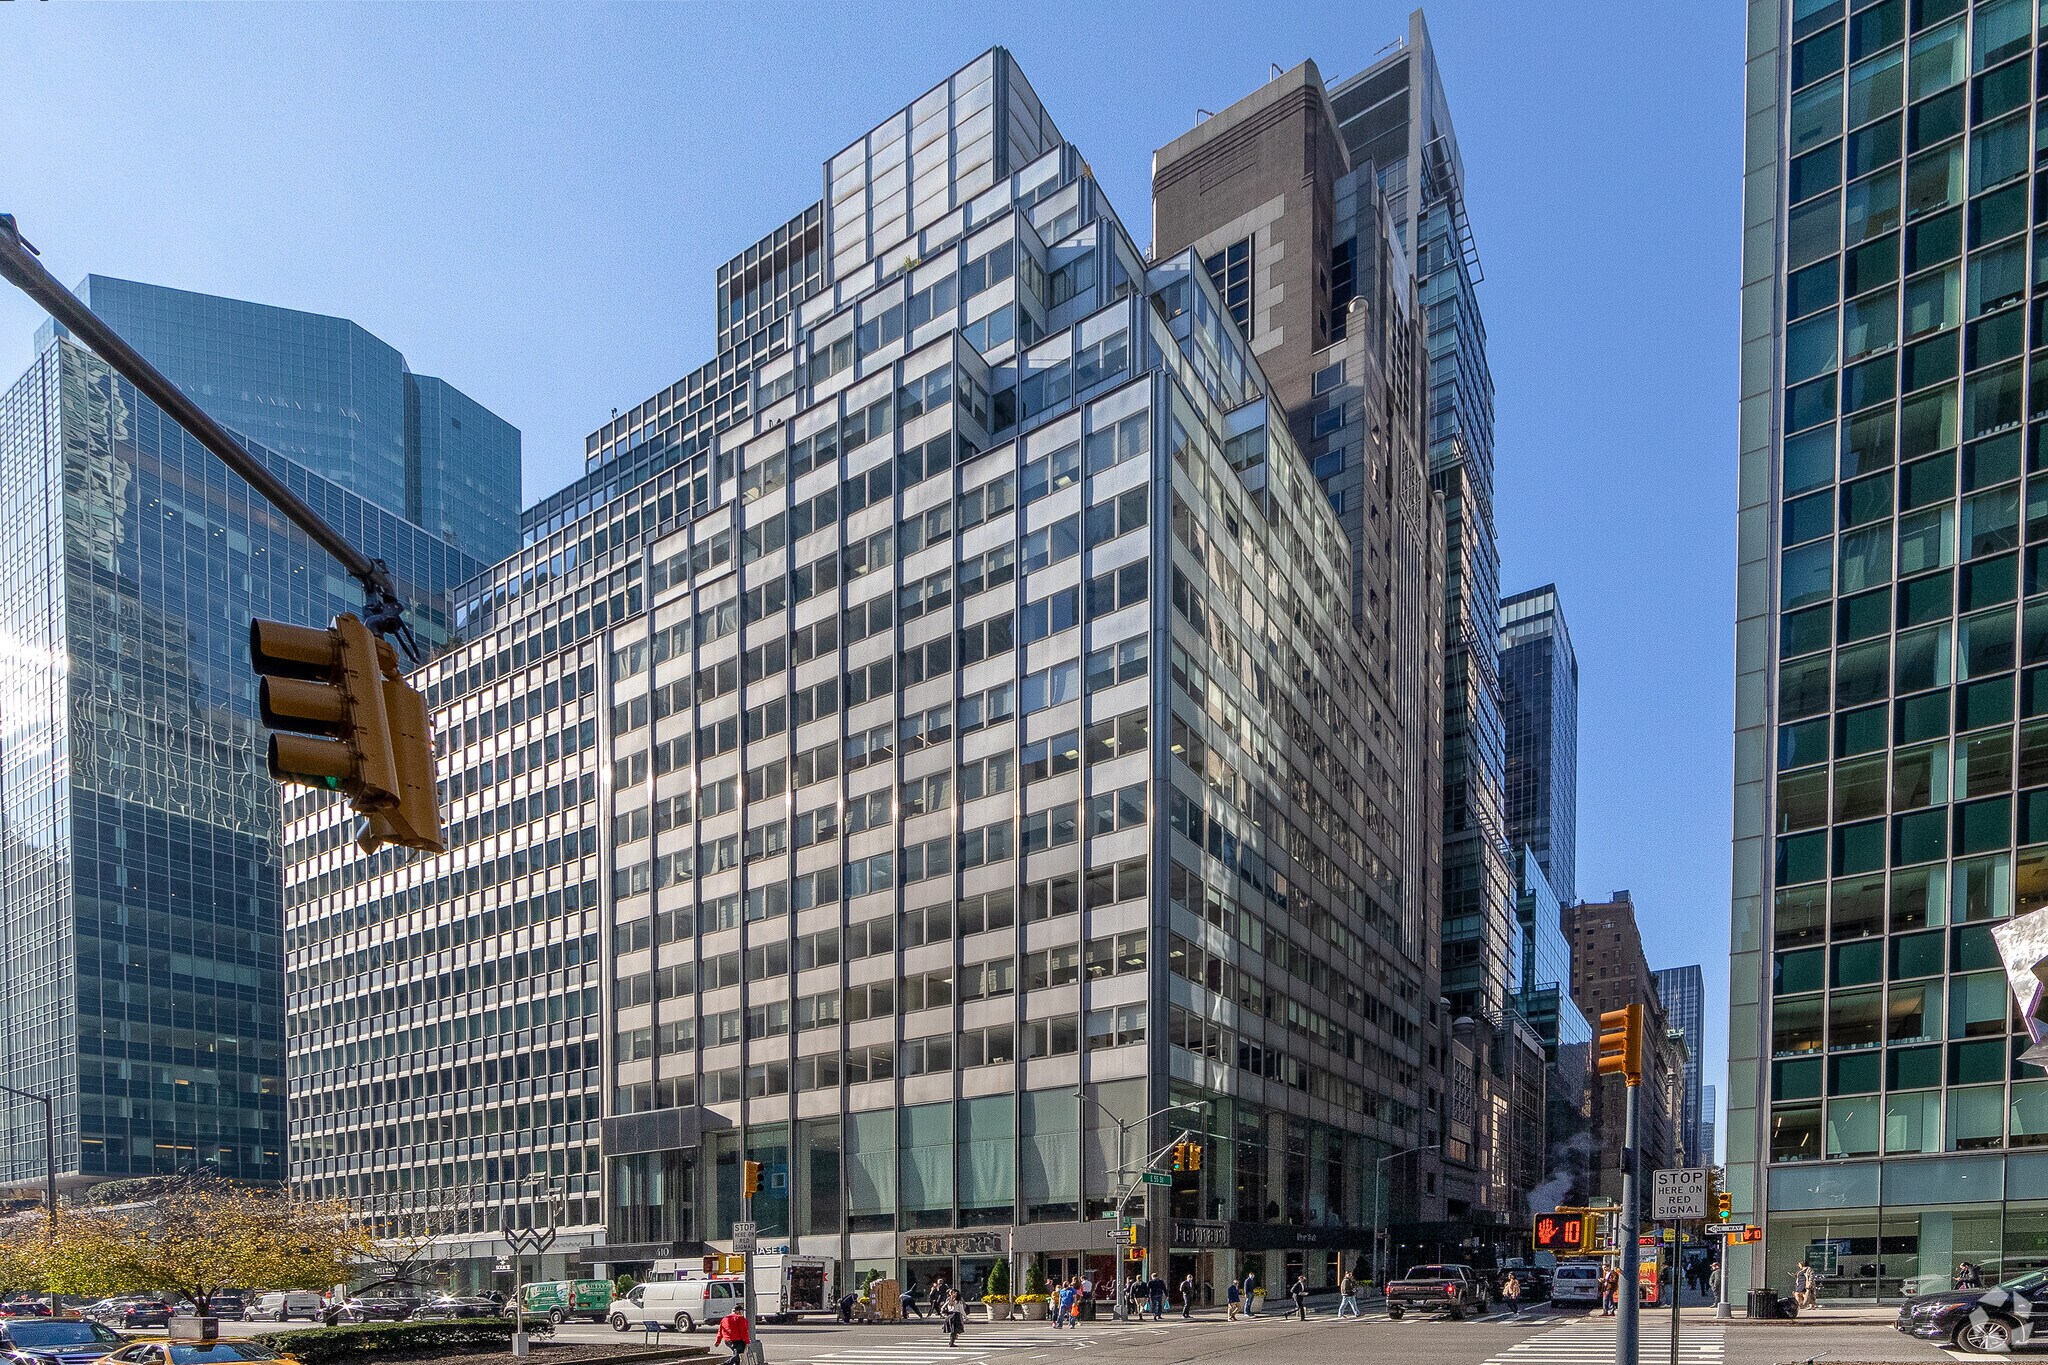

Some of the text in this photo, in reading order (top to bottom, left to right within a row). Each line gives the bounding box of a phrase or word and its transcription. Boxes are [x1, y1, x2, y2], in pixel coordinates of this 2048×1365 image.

[1658, 1172, 1703, 1184] STOP
[1658, 1185, 1702, 1195] HERE ON
[1668, 1195, 1691, 1204] RED
[1658, 1205, 1701, 1214] SIGNAL
[1174, 1222, 1227, 1243] Ferrari
[1564, 1220, 1581, 1243] 10
[656, 1247, 670, 1257] 410
